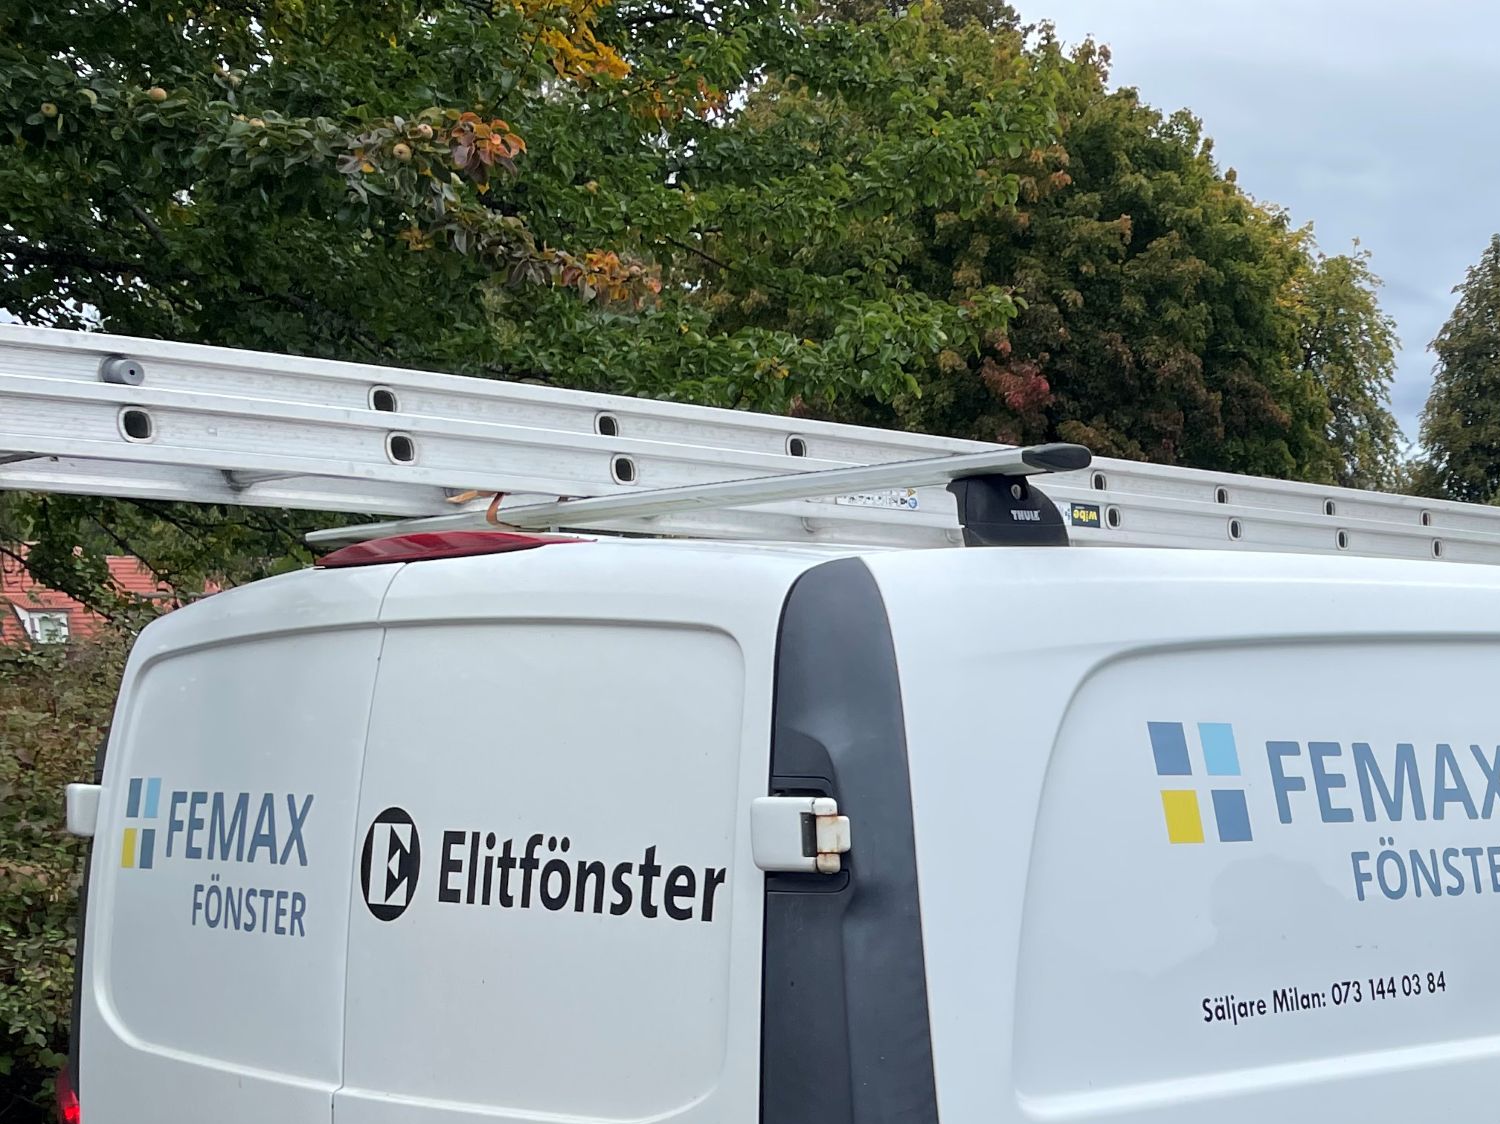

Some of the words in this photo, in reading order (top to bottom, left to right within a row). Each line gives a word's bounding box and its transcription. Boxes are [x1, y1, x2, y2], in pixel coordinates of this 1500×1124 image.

[165, 790, 315, 868] FEMAX
[191, 873, 307, 938] FÖNSTER
[438, 829, 728, 923] Elitfönster
[1202, 994, 1267, 1026] Säljare
[1272, 986, 1327, 1014] Milan:
[1331, 980, 1363, 1006] 073
[1368, 976, 1397, 1001] 144
[1401, 973, 1422, 997] 03
[1427, 970, 1447, 994] 84
